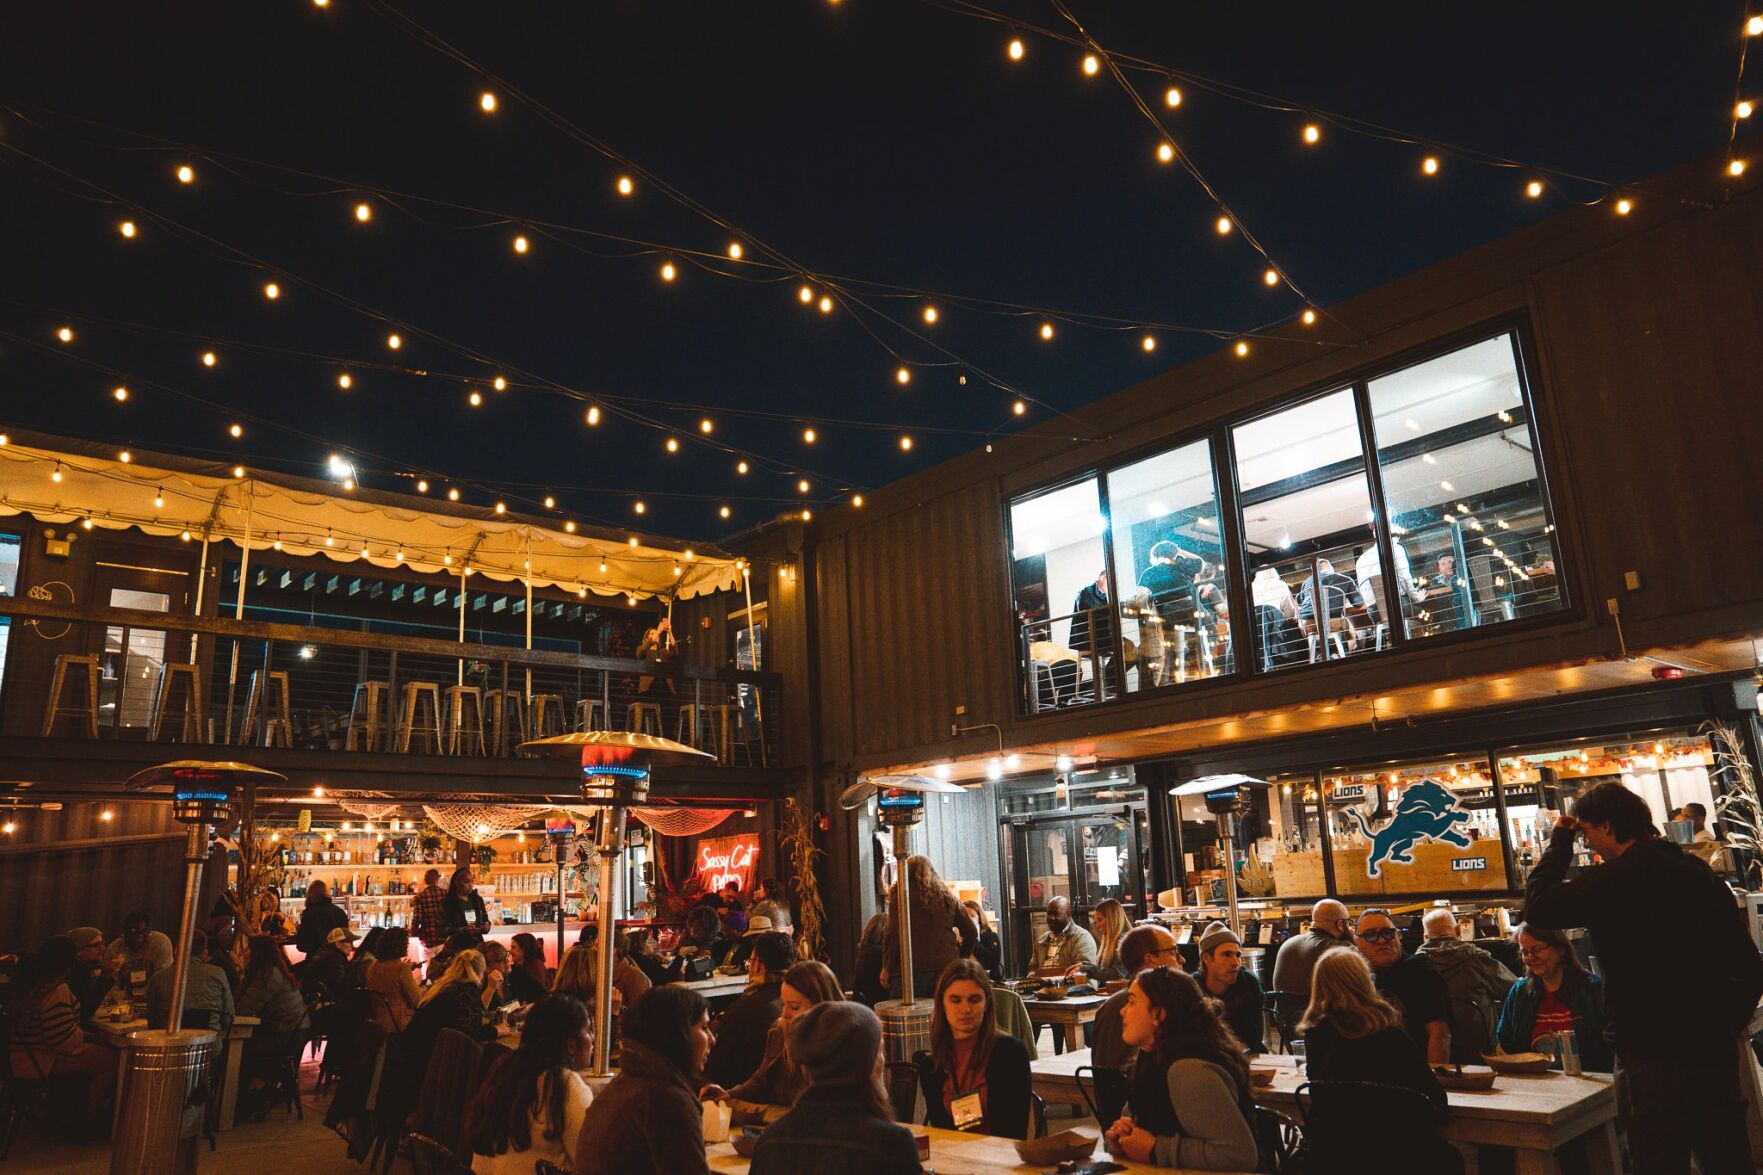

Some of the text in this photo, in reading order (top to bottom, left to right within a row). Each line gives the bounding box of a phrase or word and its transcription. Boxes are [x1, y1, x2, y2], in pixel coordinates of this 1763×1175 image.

[1334, 785, 1363, 798] LIONS
[699, 844, 759, 876] Sassy Cat
[1452, 858, 1485, 871] LIONS
